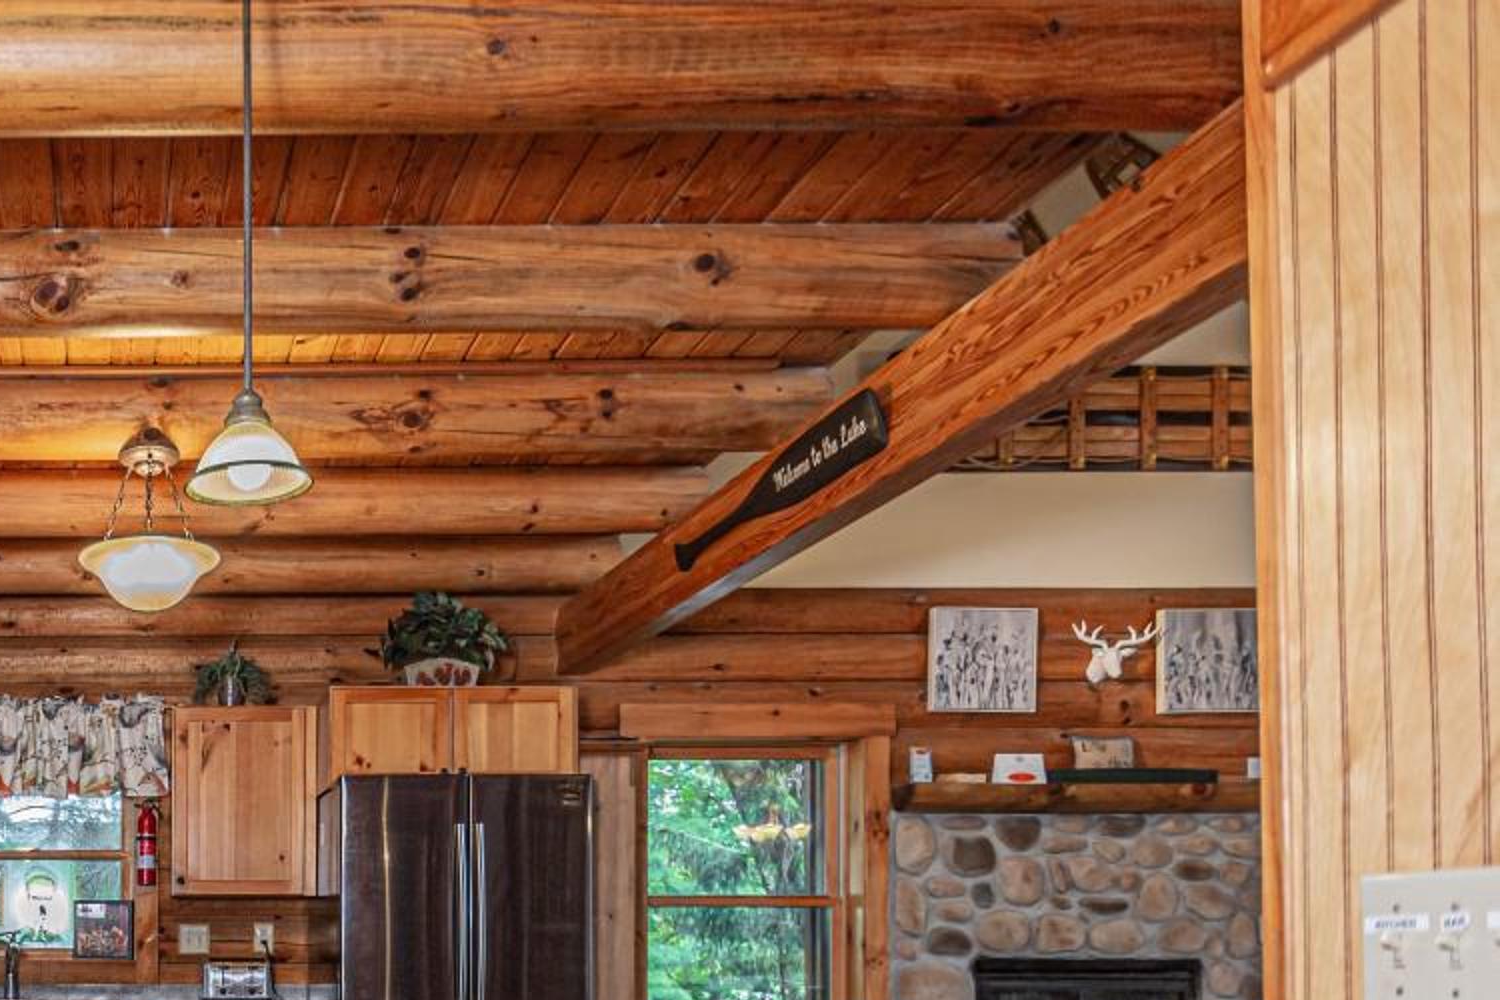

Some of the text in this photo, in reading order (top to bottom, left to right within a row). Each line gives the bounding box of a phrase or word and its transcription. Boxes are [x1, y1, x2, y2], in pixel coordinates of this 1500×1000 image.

[773, 416, 866, 492] Welcome to the Lake
